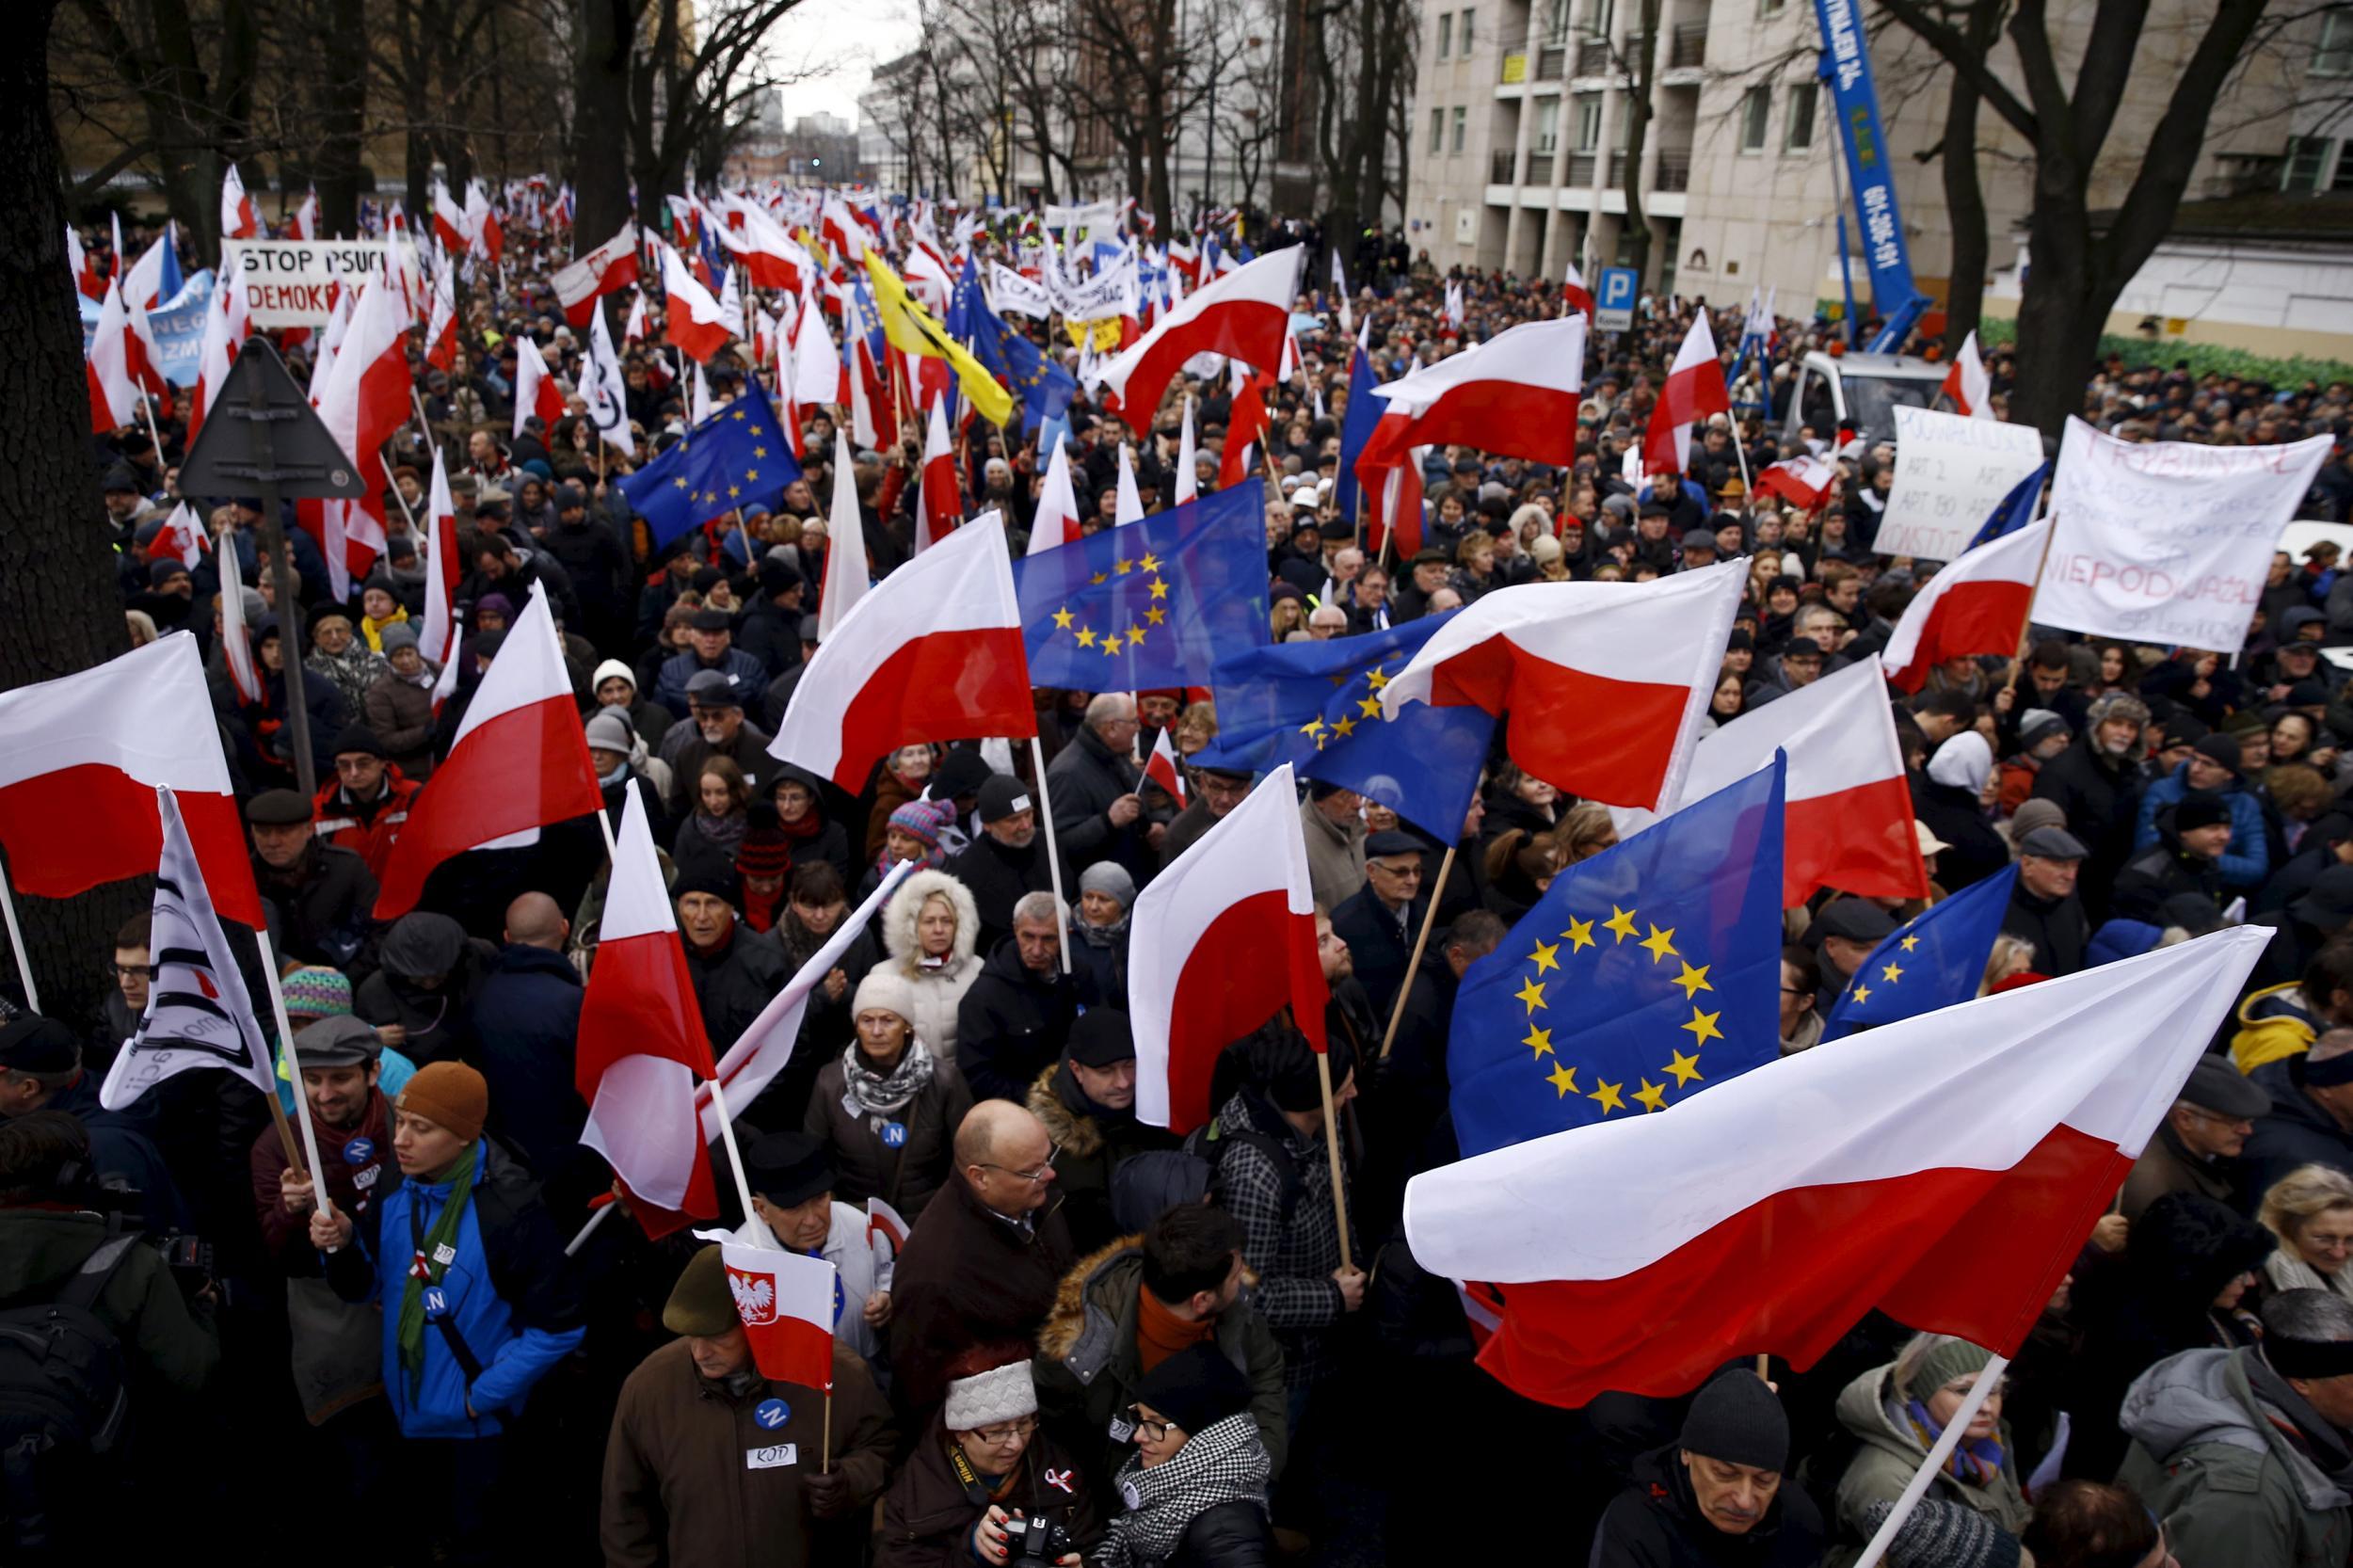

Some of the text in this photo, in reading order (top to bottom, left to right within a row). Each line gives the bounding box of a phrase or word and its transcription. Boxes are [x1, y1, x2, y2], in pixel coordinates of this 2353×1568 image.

[242, 250, 312, 271] STOP
[1607, 273, 1629, 305] P
[757, 1446, 789, 1463] KOD
[954, 1454, 974, 1483] Nikon
